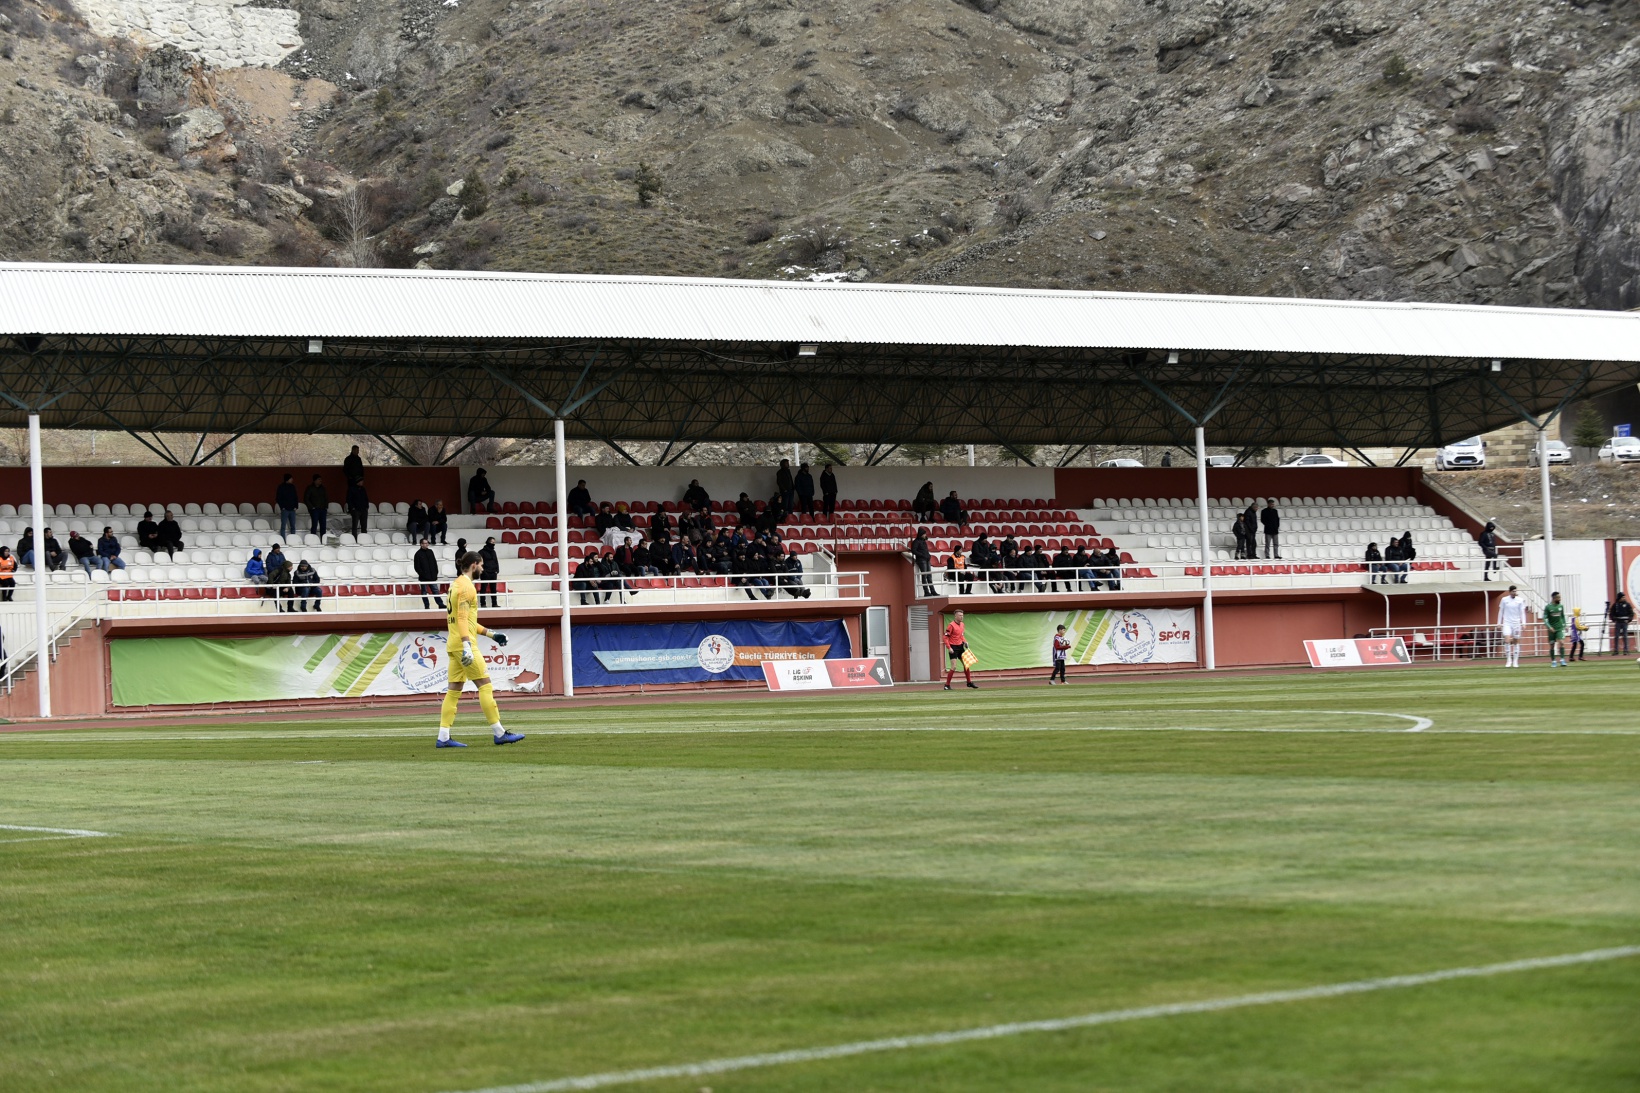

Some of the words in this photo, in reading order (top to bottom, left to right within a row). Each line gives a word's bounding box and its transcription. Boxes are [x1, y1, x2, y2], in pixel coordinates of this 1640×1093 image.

[1158, 631, 1191, 641] SPOR
[483, 655, 520, 666] POR
[739, 652, 762, 661] Güçlü
[764, 651, 797, 660] TÜRKİYE
